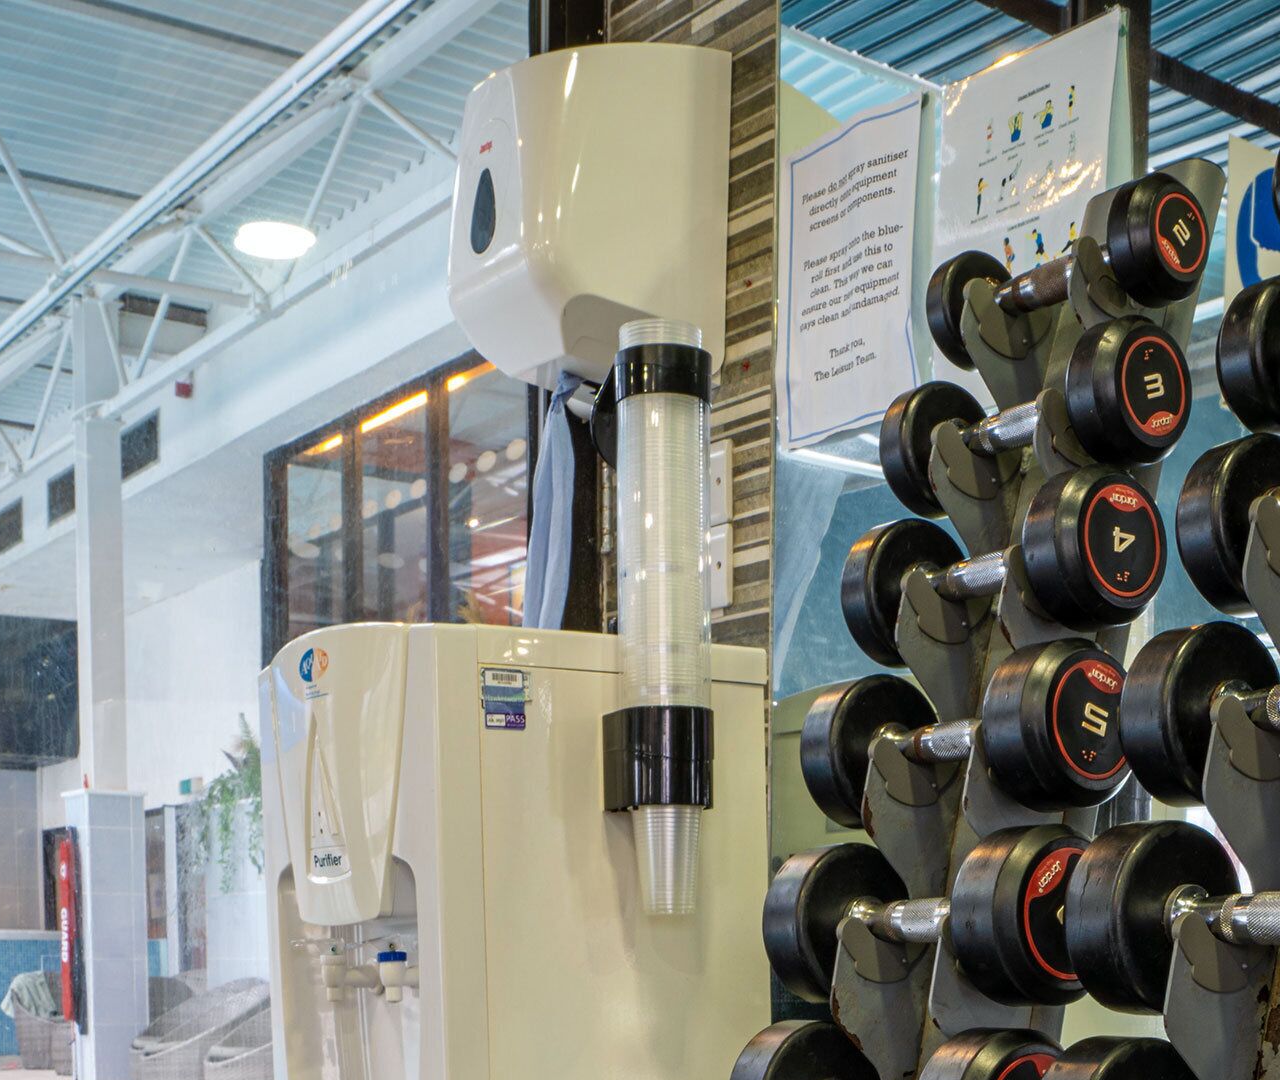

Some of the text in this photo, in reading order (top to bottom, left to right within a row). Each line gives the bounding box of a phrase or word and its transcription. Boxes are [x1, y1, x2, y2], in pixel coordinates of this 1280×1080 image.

[801, 188, 826, 205] Please
[828, 181, 838, 193] do
[848, 162, 866, 180] spray
[867, 149, 908, 168] sanitiser
[809, 196, 838, 216] directly
[851, 169, 897, 192] equipment
[809, 214, 839, 232] screens
[847, 186, 896, 213] components.
[803, 254, 827, 271] Please
[829, 246, 848, 262] spray
[862, 228, 875, 241] the
[877, 224, 903, 238] blue-
[1173, 219, 1190, 247] 2
[810, 284, 831, 298] clean.
[833, 276, 848, 289] This
[861, 264, 875, 274] we
[876, 259, 893, 271] can
[811, 271, 823, 284] roll
[824, 265, 840, 278] first
[841, 257, 852, 271] and
[864, 245, 881, 256] this
[883, 243, 893, 252] to
[801, 301, 827, 316] ensure
[828, 296, 842, 307] our
[854, 272, 900, 293] equipment
[817, 312, 840, 325] clean
[851, 286, 900, 311] undamaged.
[814, 350, 877, 381] The Leisure Team.
[829, 344, 850, 359] Thank
[1144, 373, 1165, 399] 3
[1113, 526, 1135, 552] 4
[506, 714, 525, 724] PASS
[1081, 702, 1109, 738] 5
[314, 853, 342, 868] Purifier
[60, 907, 69, 963] GUARD
